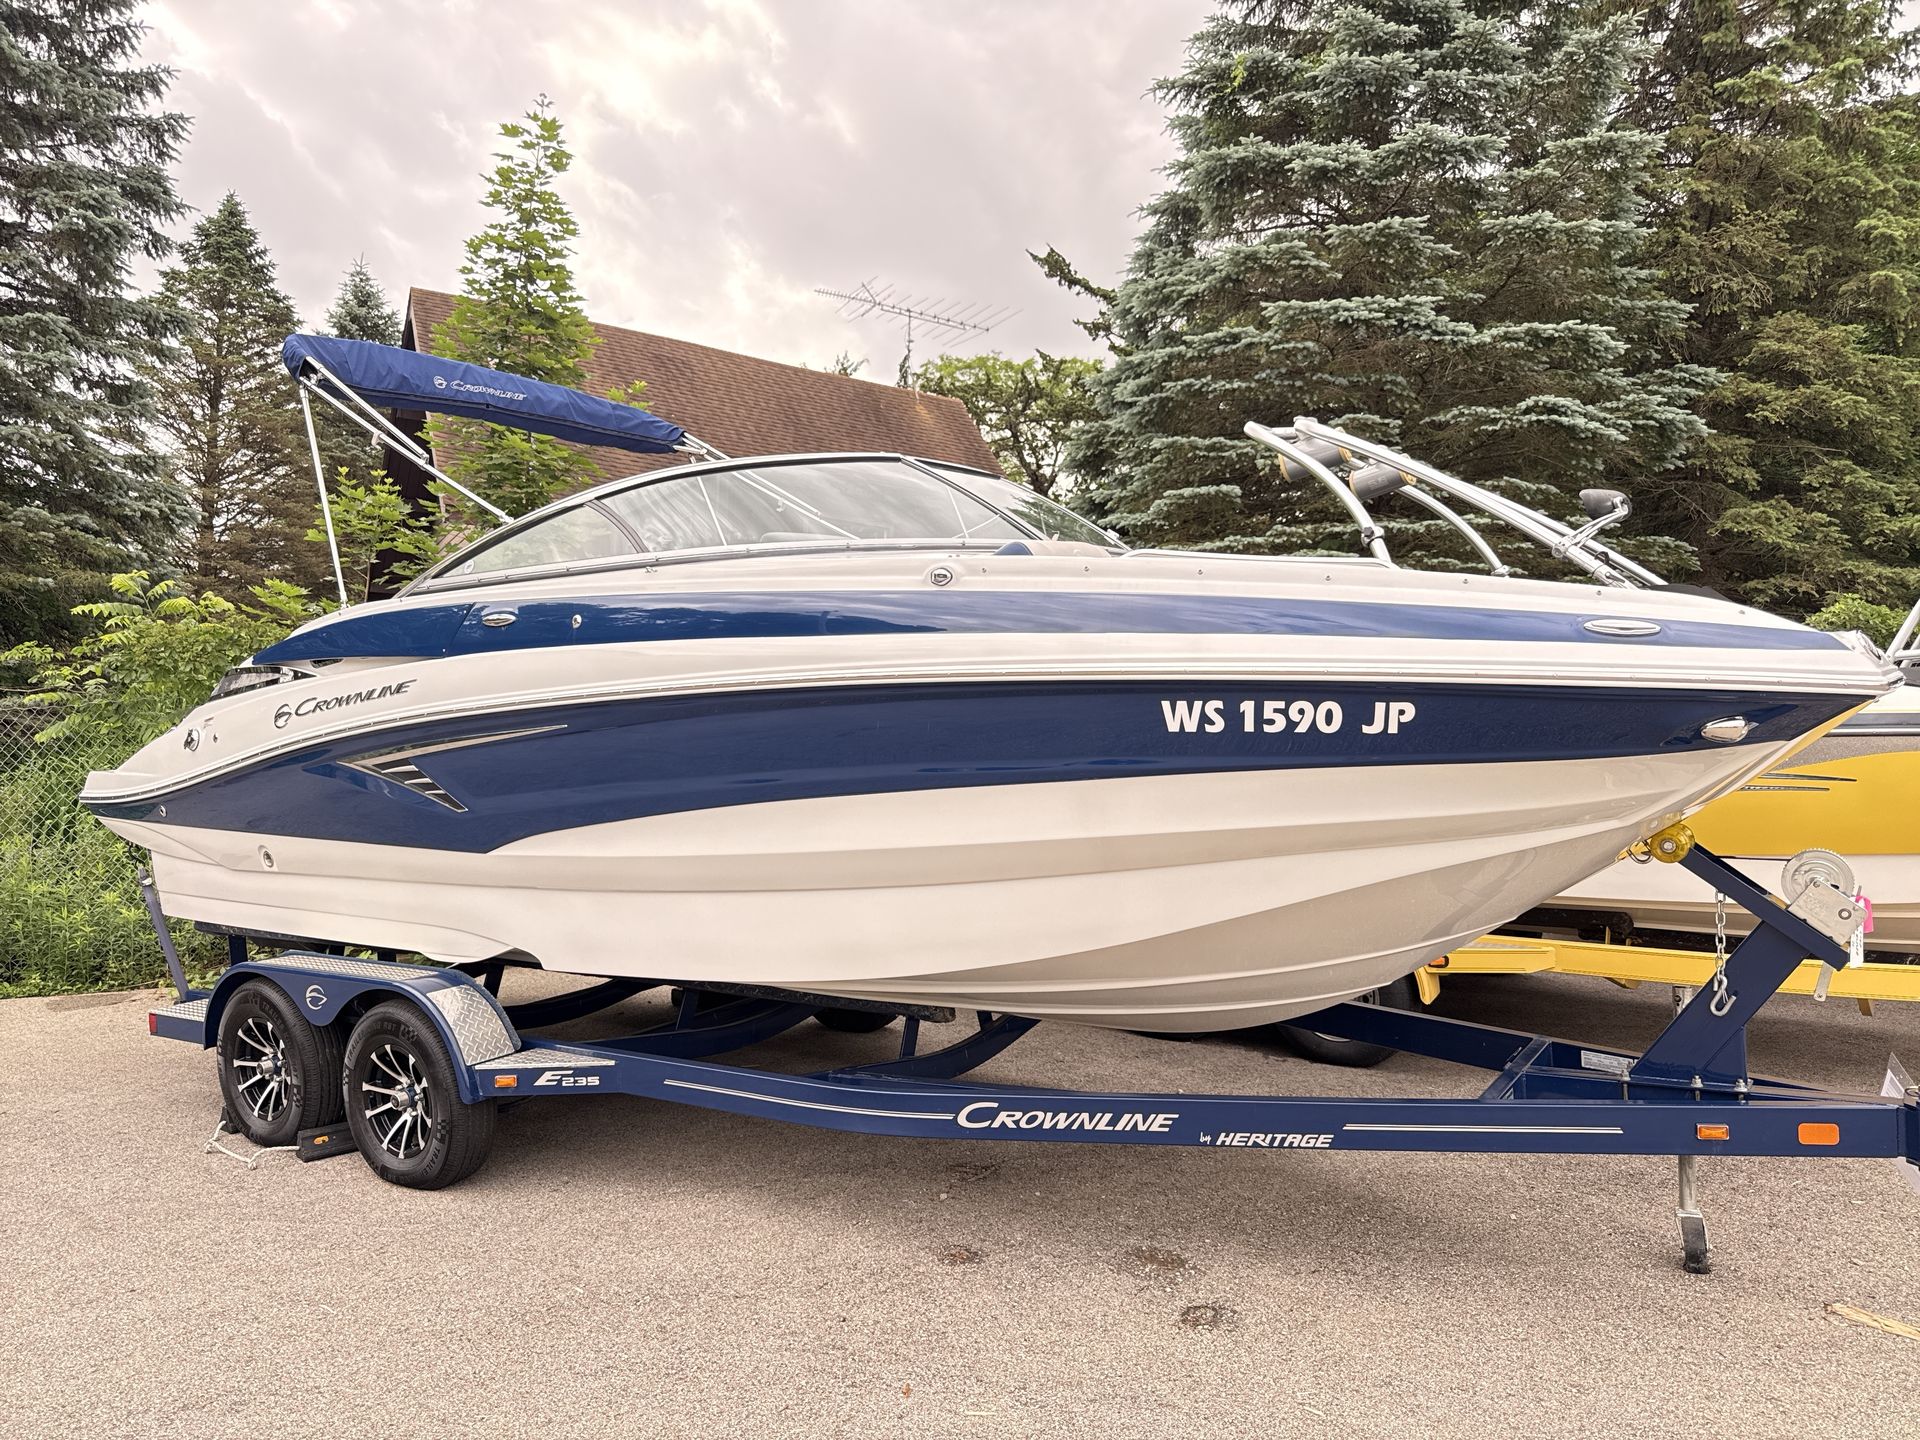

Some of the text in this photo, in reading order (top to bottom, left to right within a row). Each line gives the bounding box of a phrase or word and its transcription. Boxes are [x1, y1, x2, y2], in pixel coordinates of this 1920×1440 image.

[294, 679, 418, 717] CROWNLINE
[1160, 700, 1416, 735] WS 1590 JP
[956, 1101, 1180, 1132] CROWNLINE
[1199, 1131, 1335, 1149] by HERITAGE
